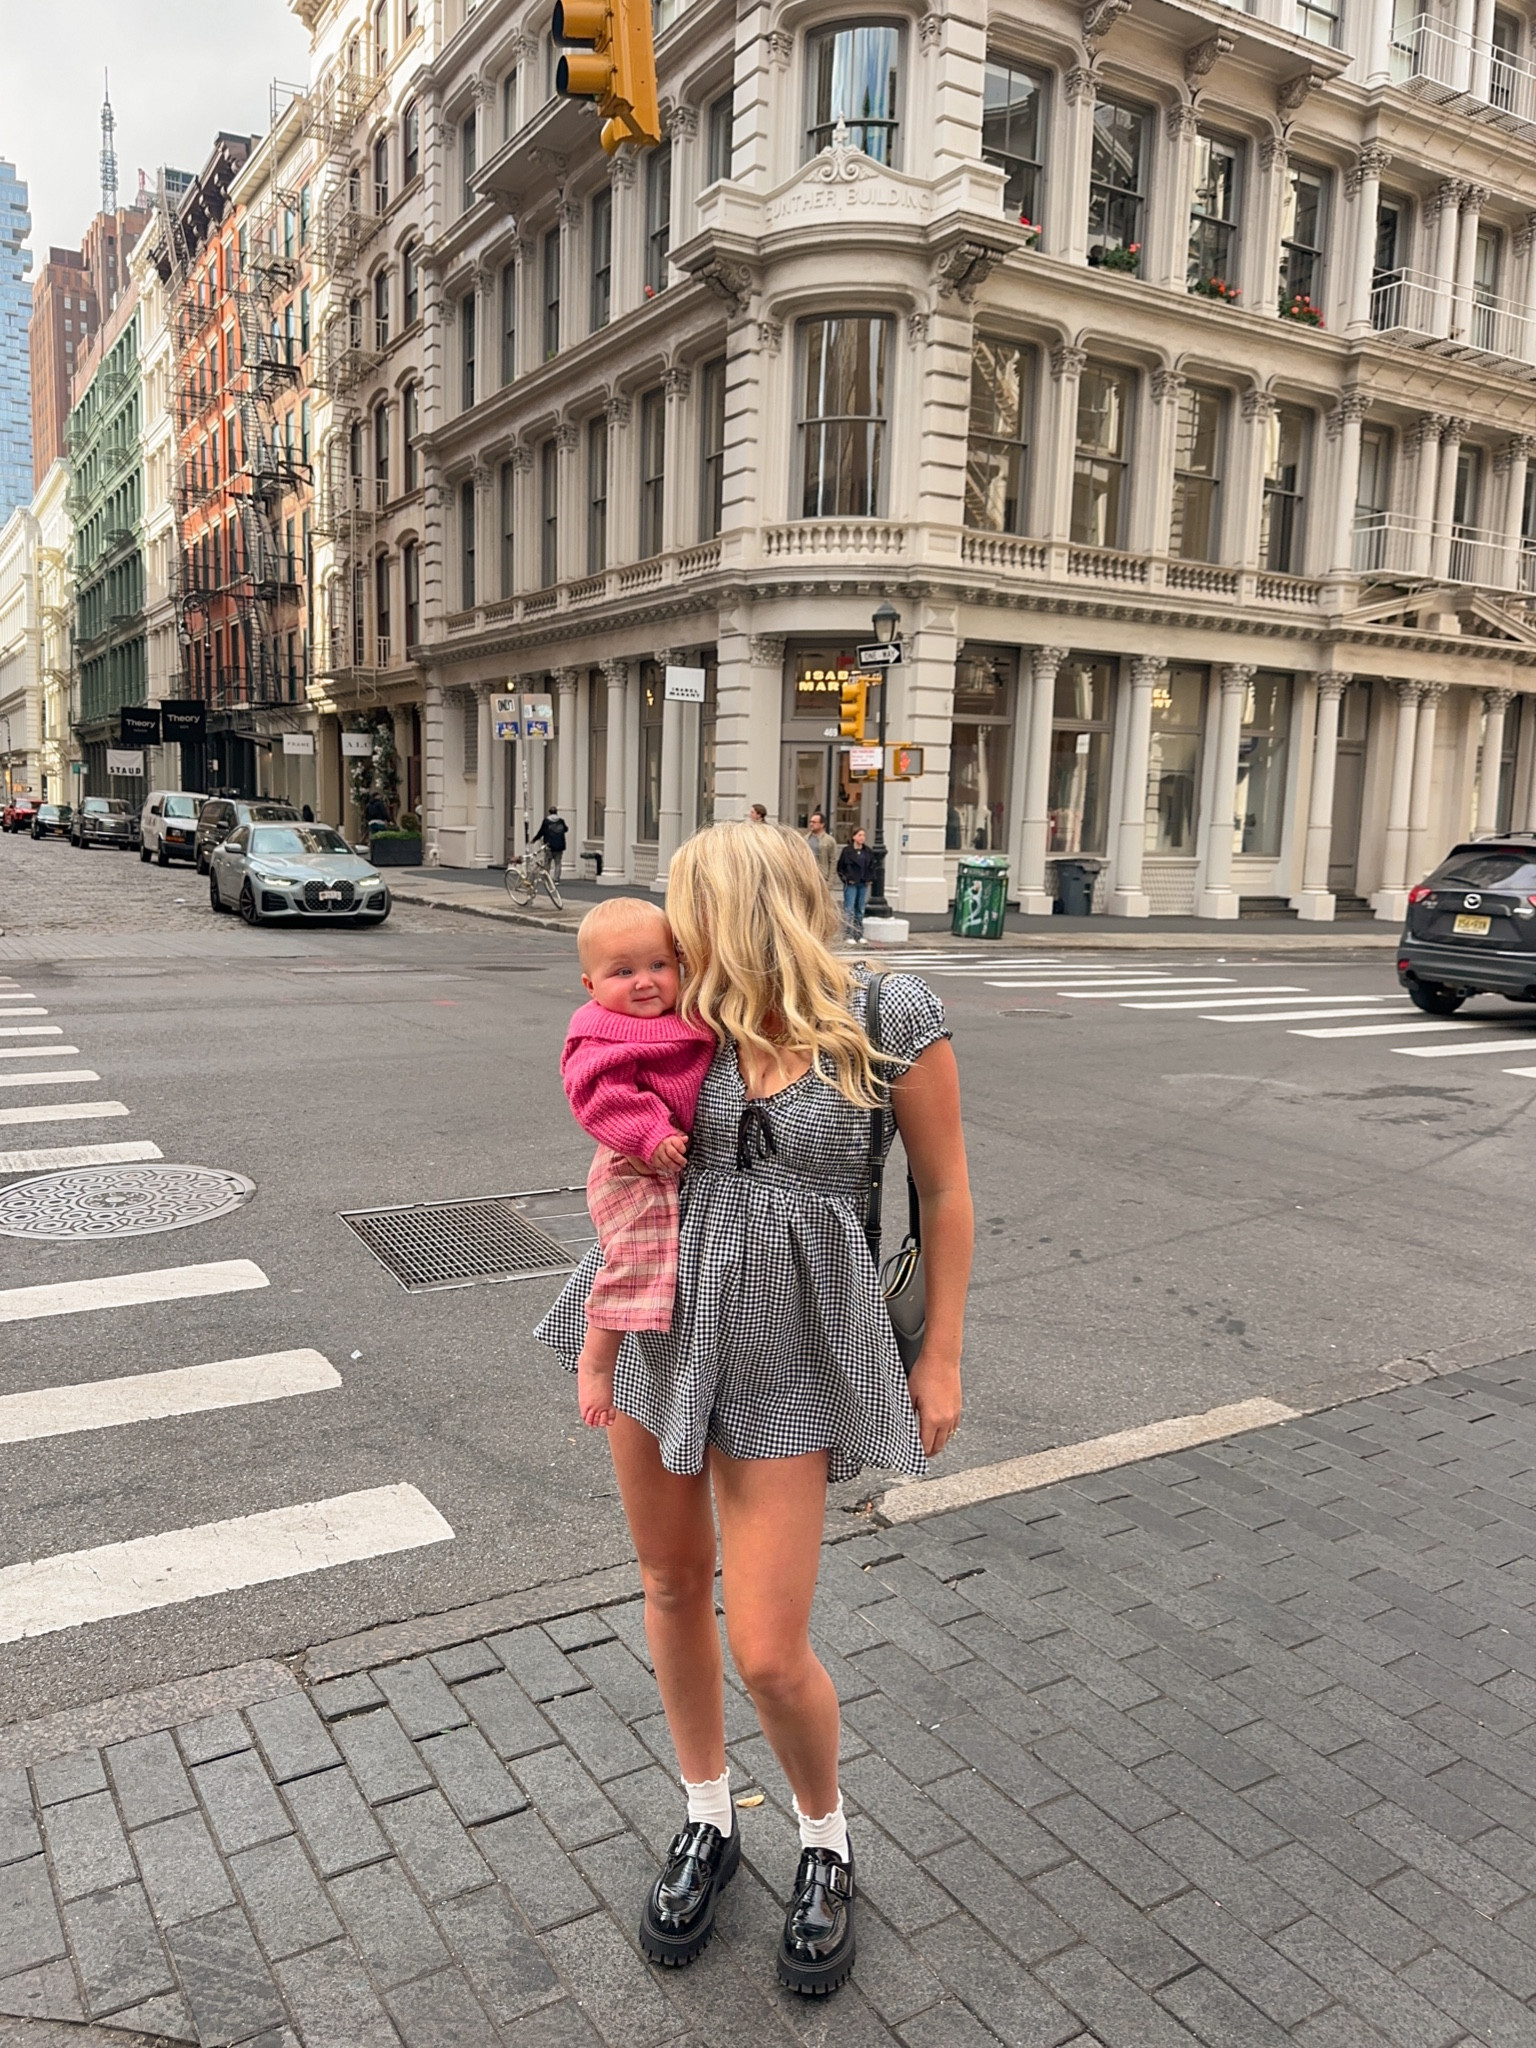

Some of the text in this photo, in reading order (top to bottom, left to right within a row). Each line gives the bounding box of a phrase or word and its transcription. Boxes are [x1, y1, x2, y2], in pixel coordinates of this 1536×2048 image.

[765, 188, 932, 222] GUNTHER BUILDING
[863, 650, 896, 660] ONE WAY
[166, 713, 201, 723] Theory
[125, 718, 156, 729] Theory
[110, 766, 142, 775] STAUD
